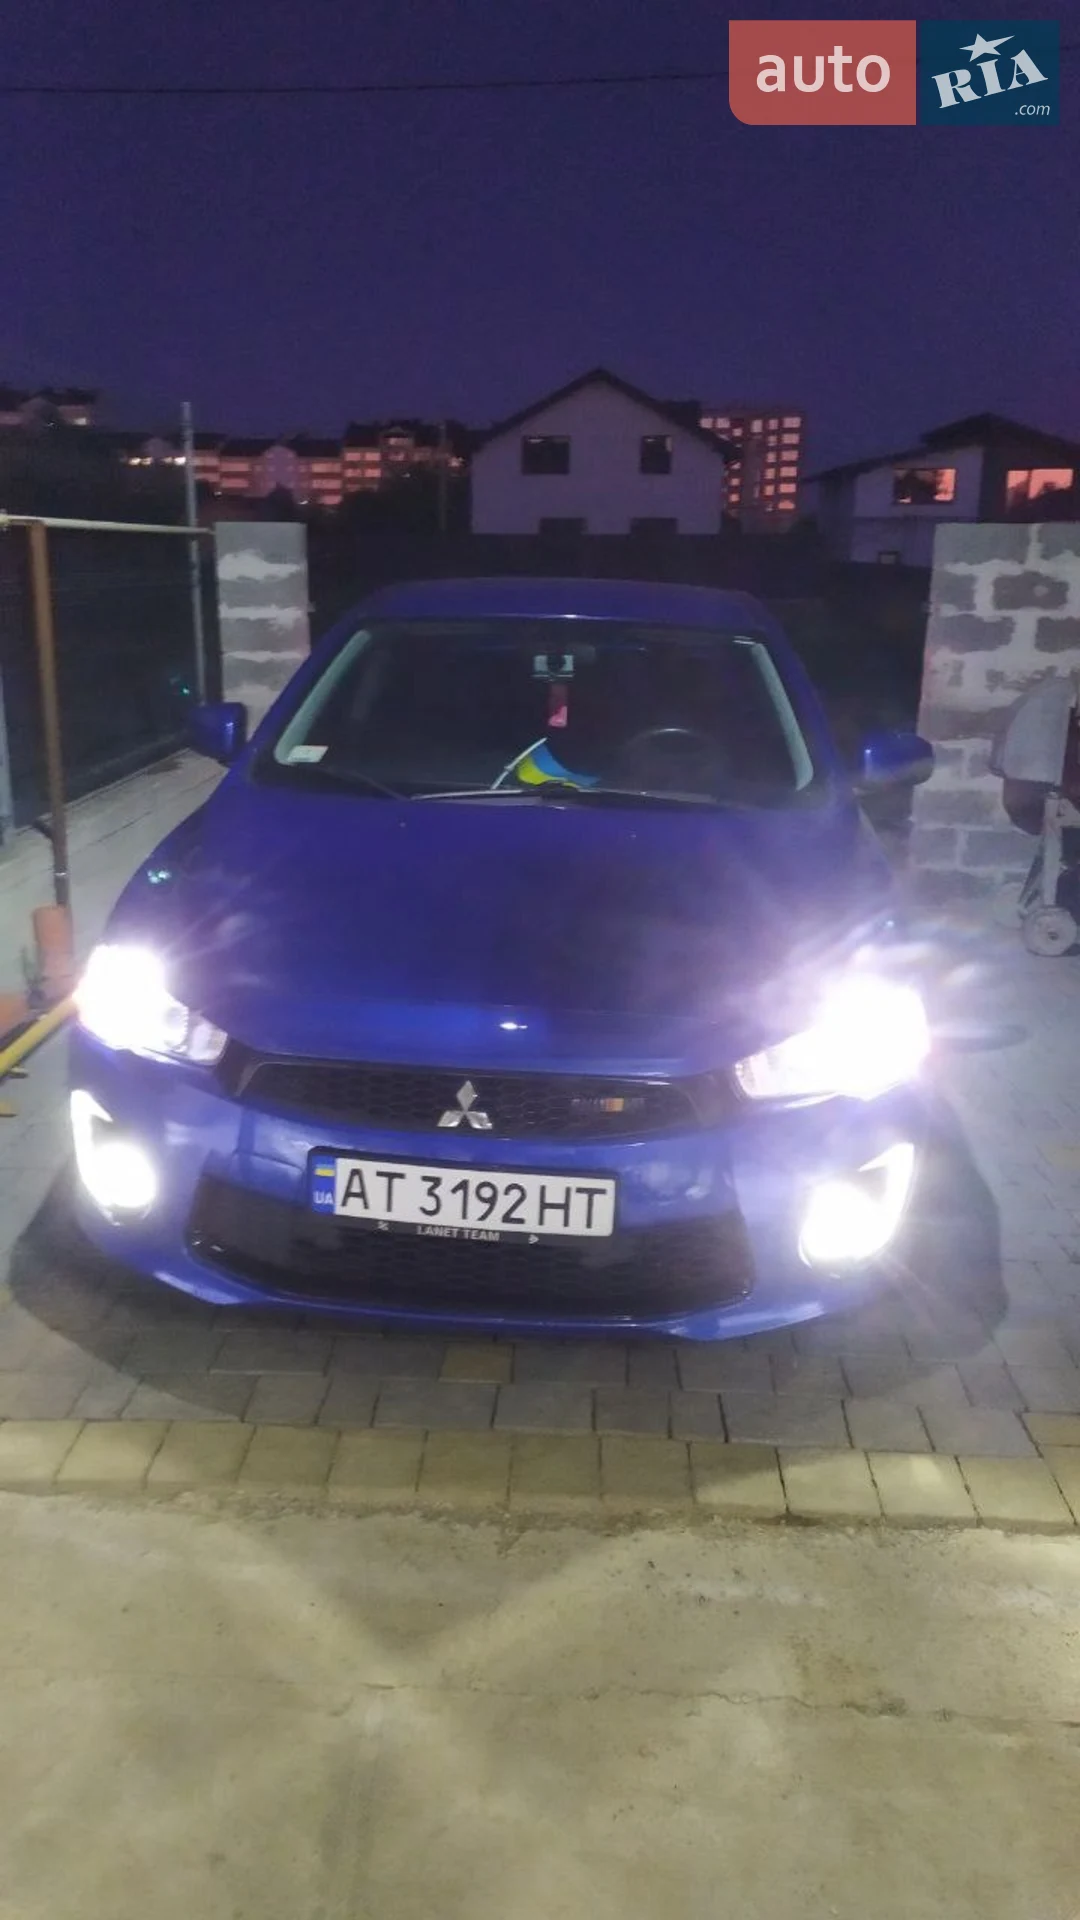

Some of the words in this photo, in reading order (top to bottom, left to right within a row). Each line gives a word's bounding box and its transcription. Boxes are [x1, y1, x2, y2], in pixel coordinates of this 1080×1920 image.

[314, 1191, 334, 1205] UA
[341, 1168, 406, 1213] AT
[419, 1175, 527, 1225] 3192
[538, 1184, 607, 1229] HT
[416, 1225, 461, 1239] LANET
[463, 1229, 500, 1242] TEAM
